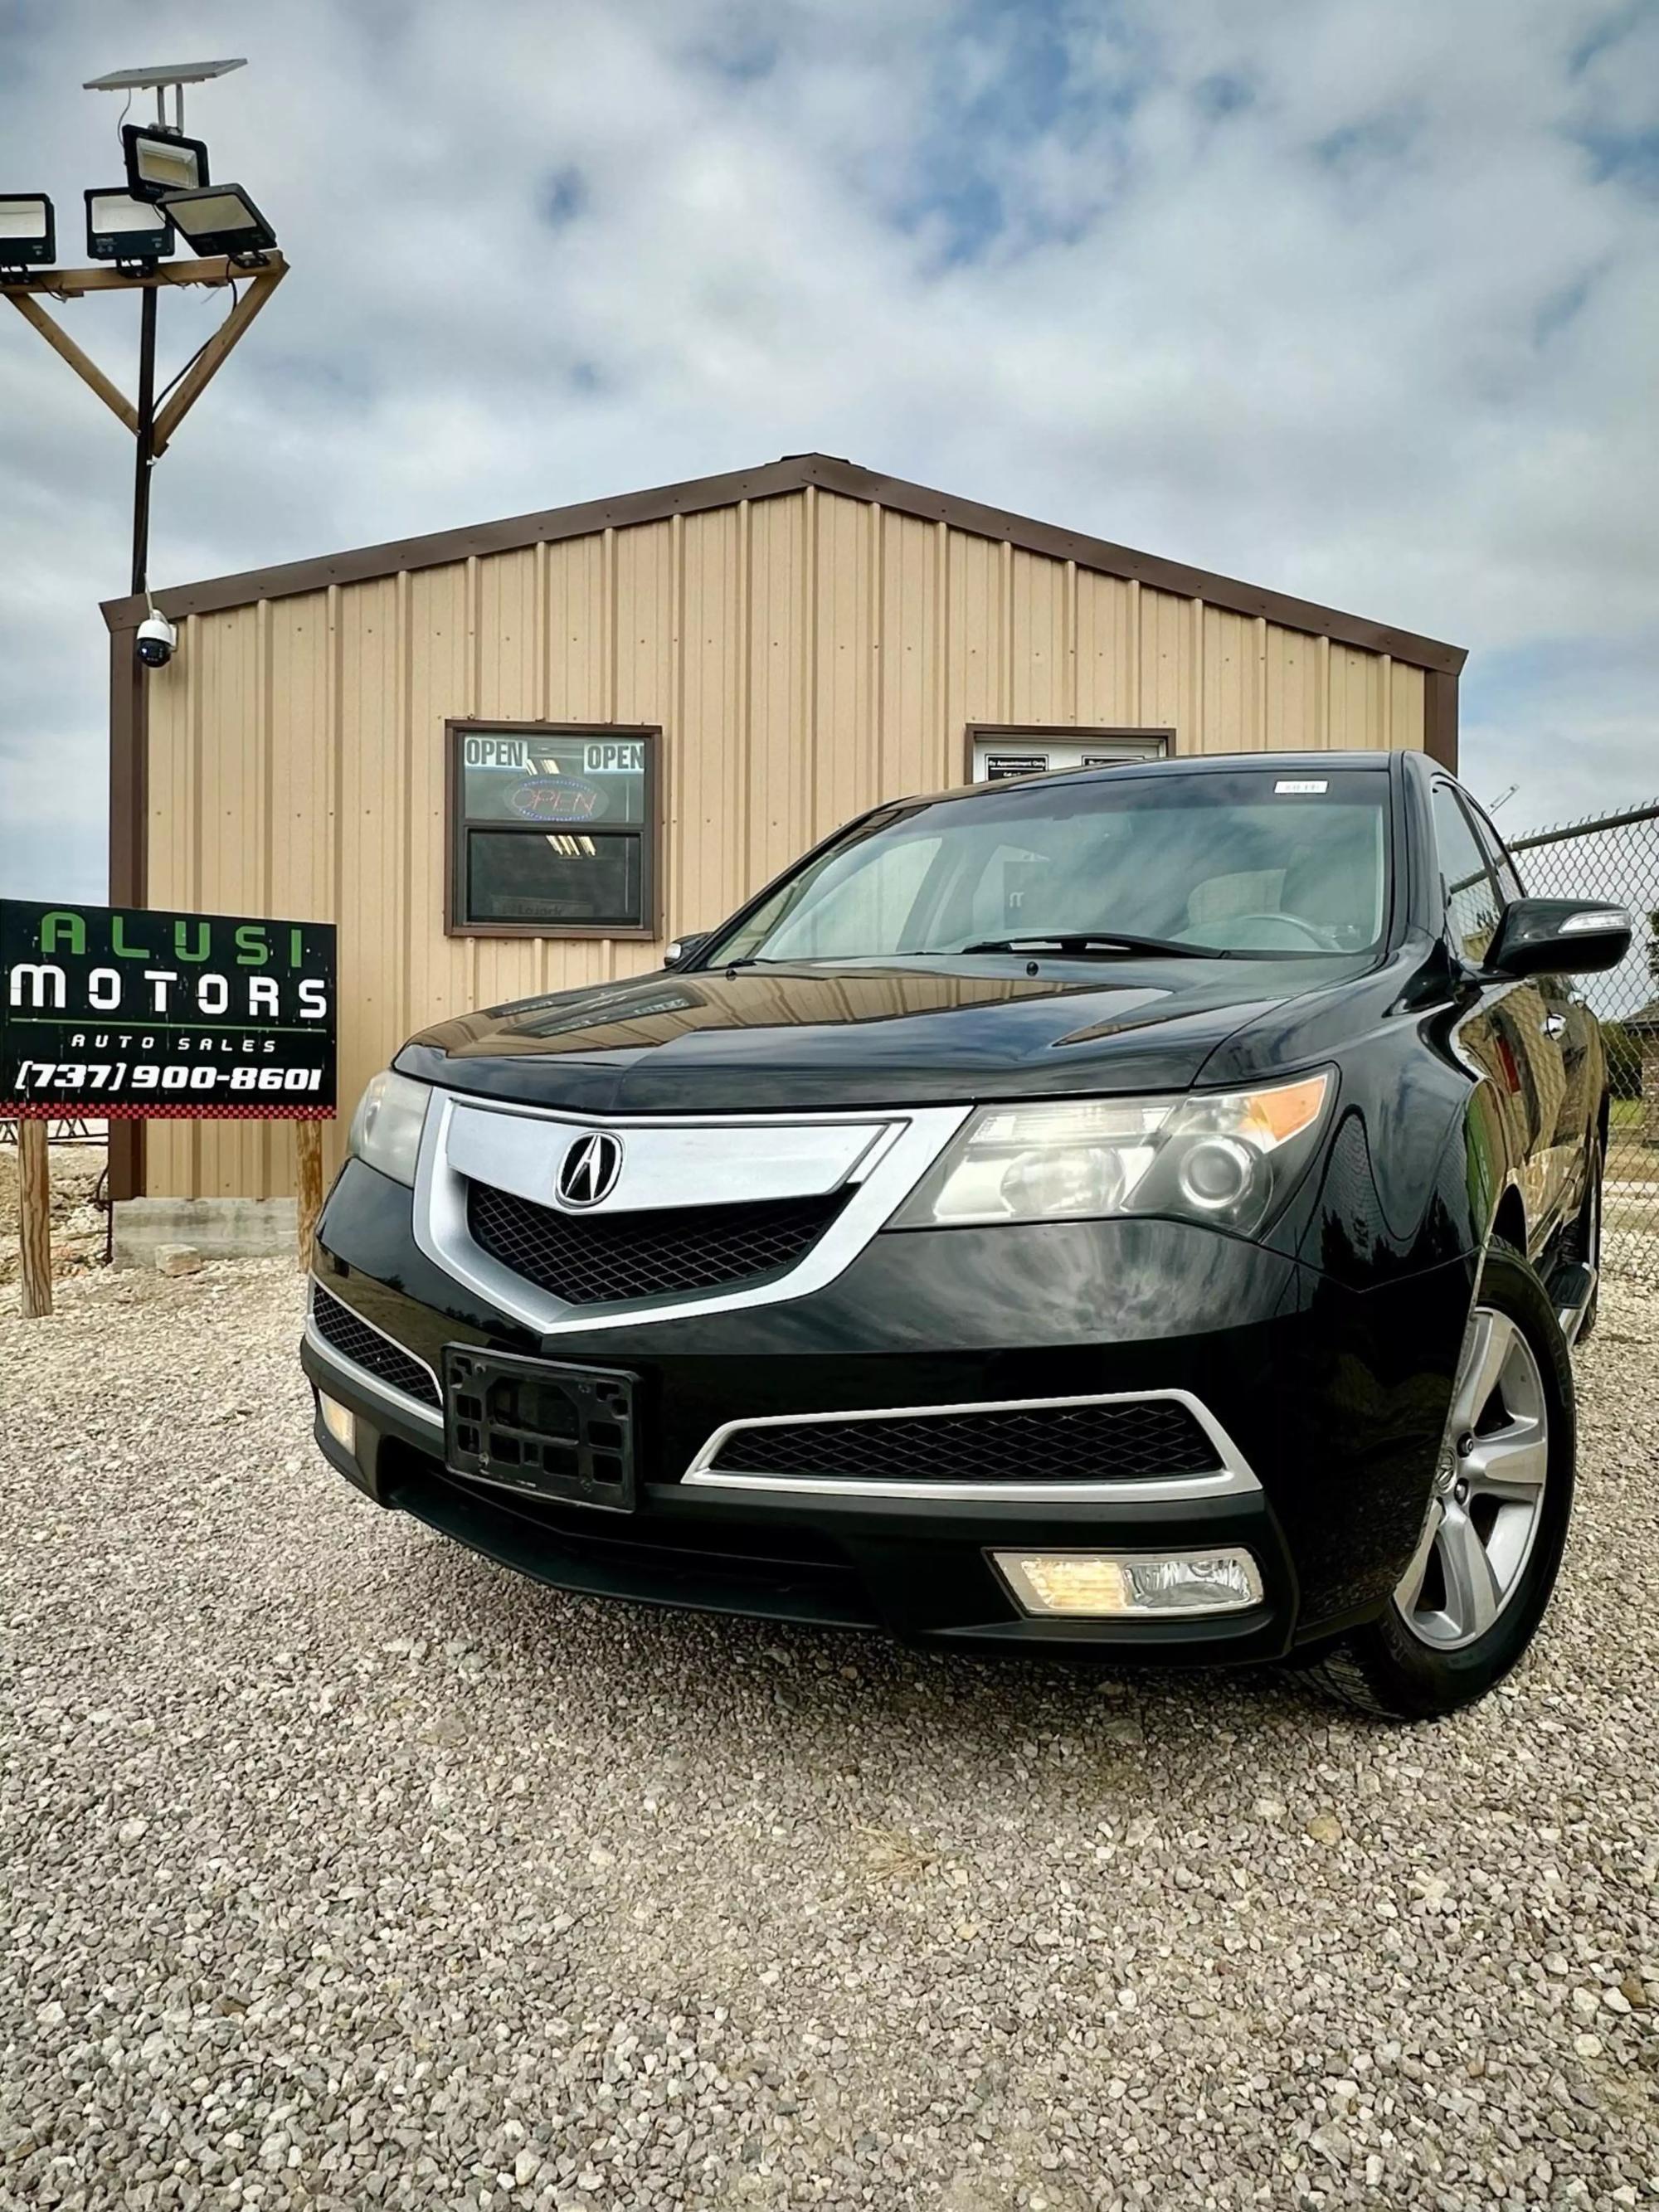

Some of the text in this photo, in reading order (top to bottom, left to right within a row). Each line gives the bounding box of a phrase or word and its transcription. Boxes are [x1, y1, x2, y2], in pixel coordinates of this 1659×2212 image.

[465, 738, 524, 767] OPEN
[586, 745, 645, 770] OPEN
[511, 787, 598, 813] OPEN
[41, 912, 303, 969] ALUSI
[10, 963, 328, 1018] MOTORS
[71, 1033, 276, 1053] AUTO SALES
